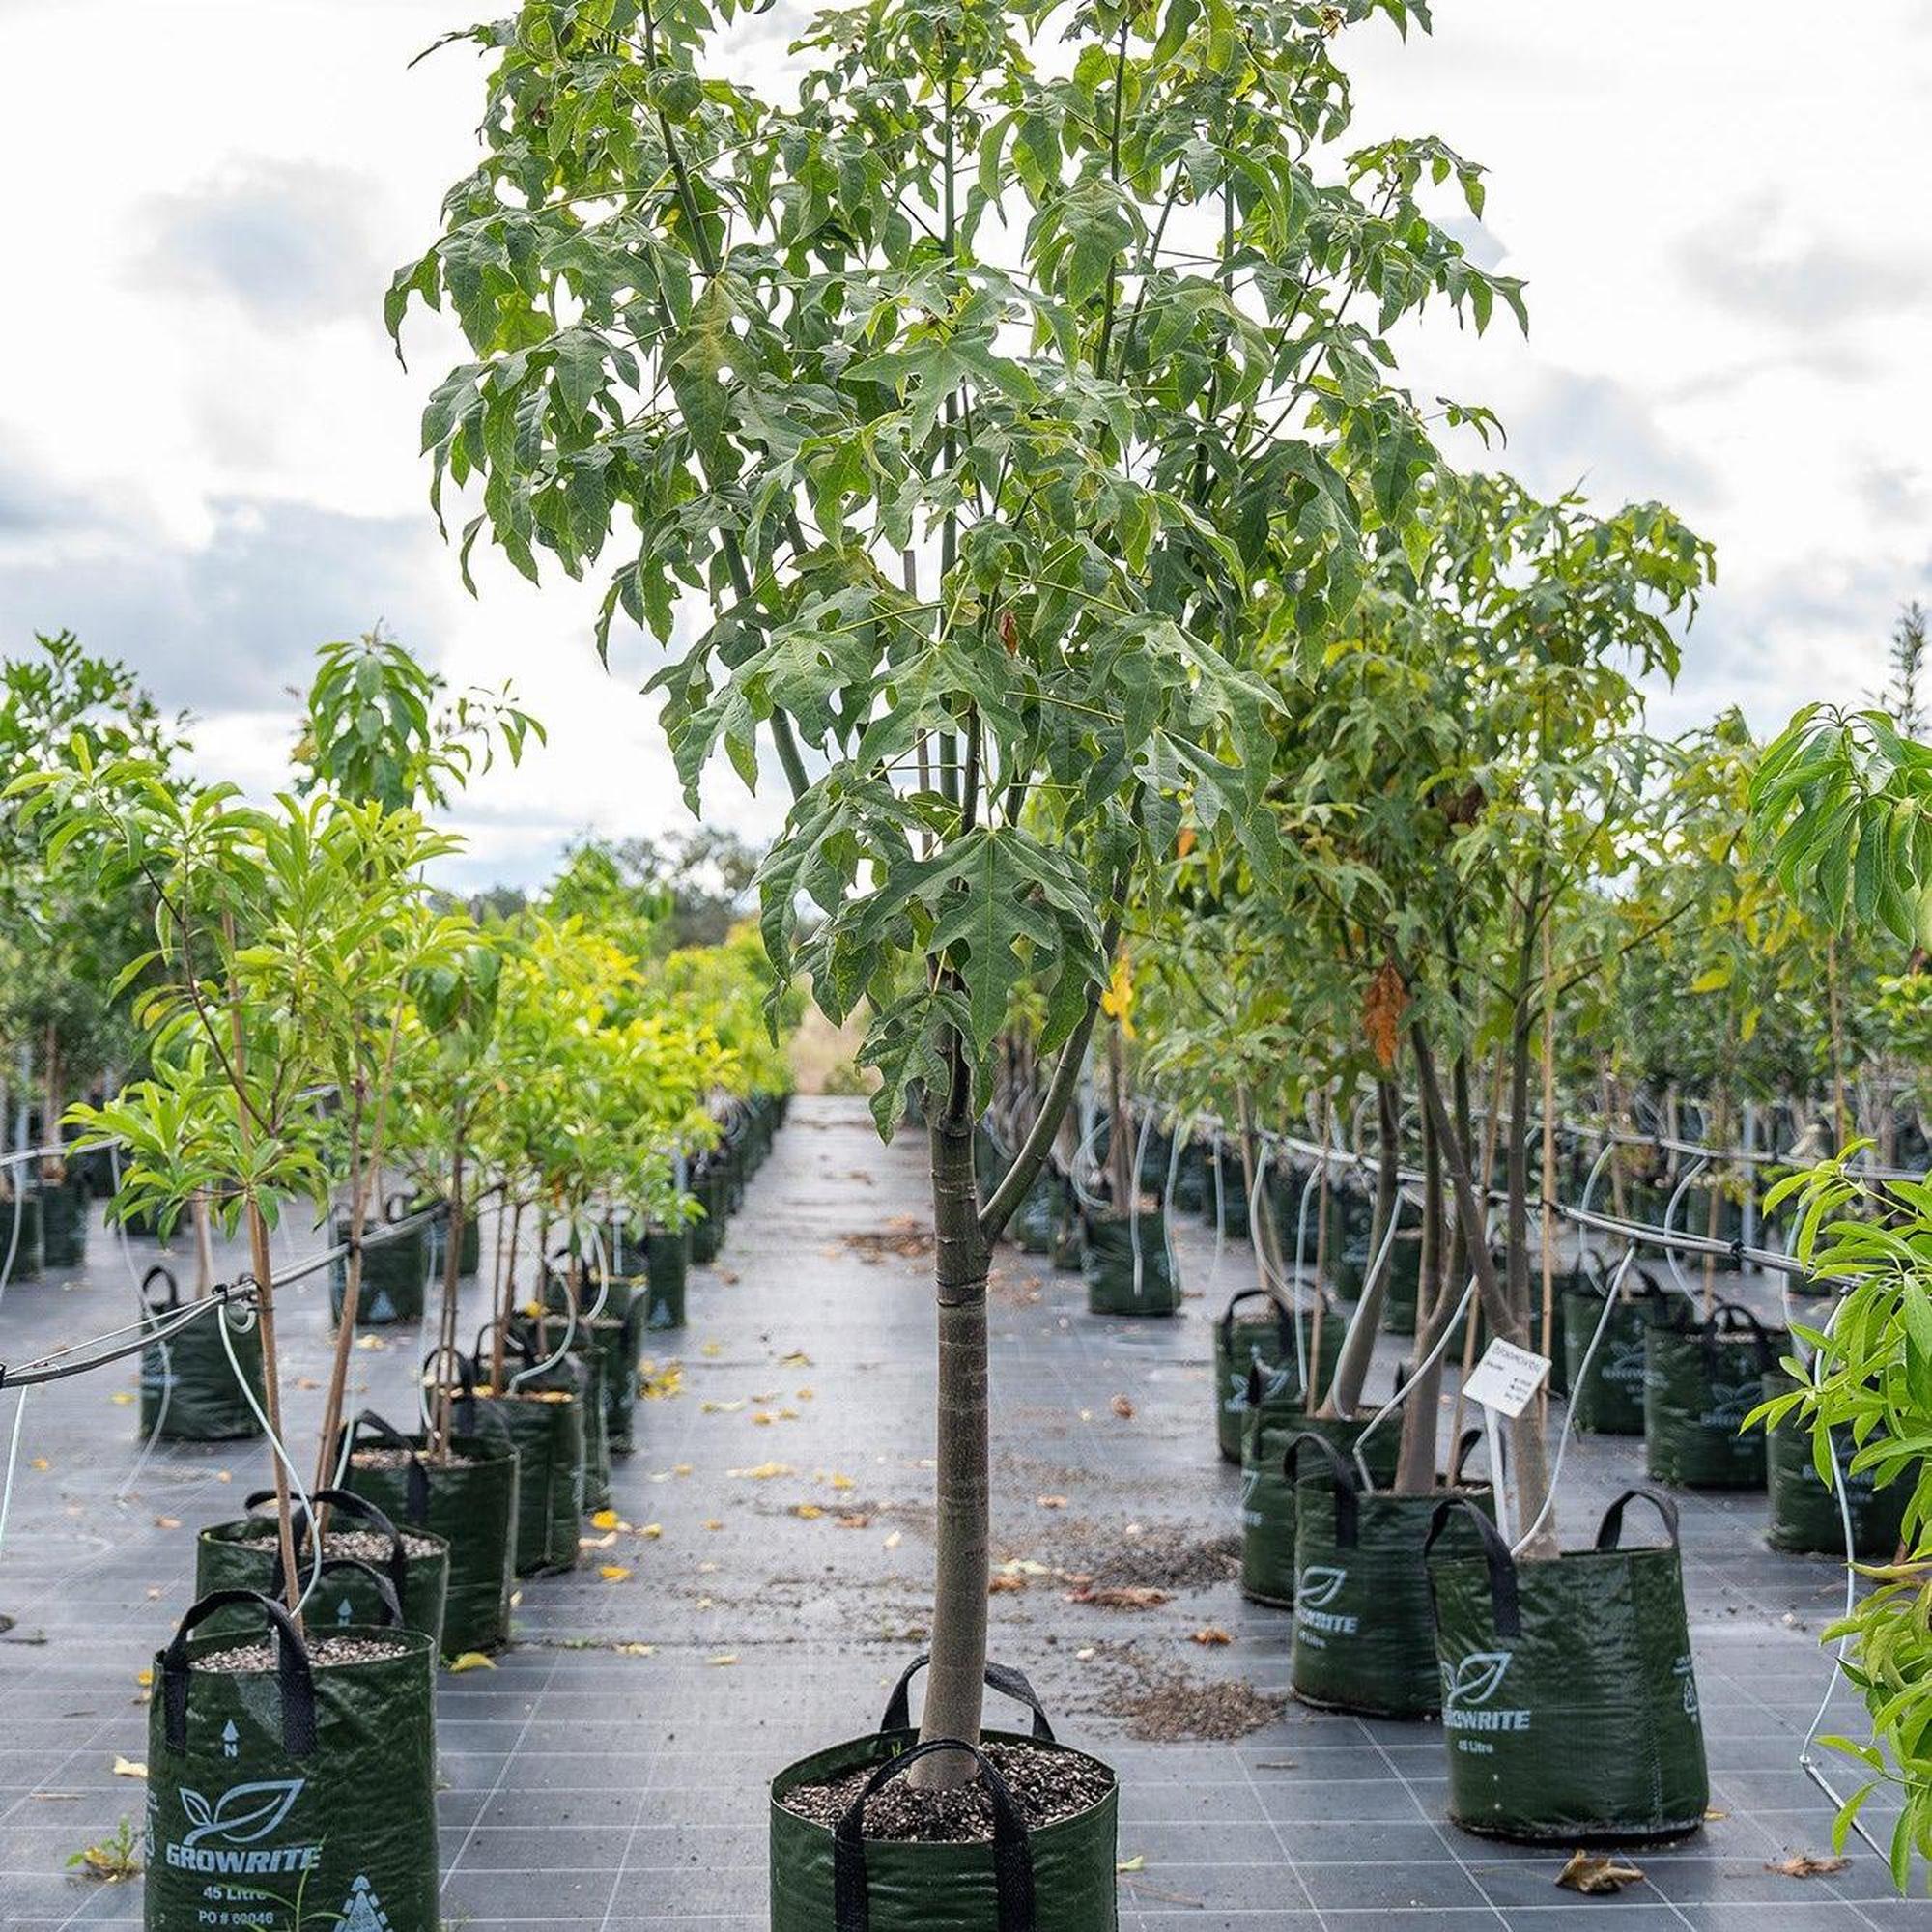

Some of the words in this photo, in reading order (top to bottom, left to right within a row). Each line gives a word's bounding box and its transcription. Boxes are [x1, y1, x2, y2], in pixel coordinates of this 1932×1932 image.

[1442, 1708, 1531, 1730] OWRITE
[224, 1744, 238, 1757] N
[166, 1841, 323, 1874] GROWRITE
[203, 1886, 222, 1900] 45
[198, 1910, 217, 1924] PO
